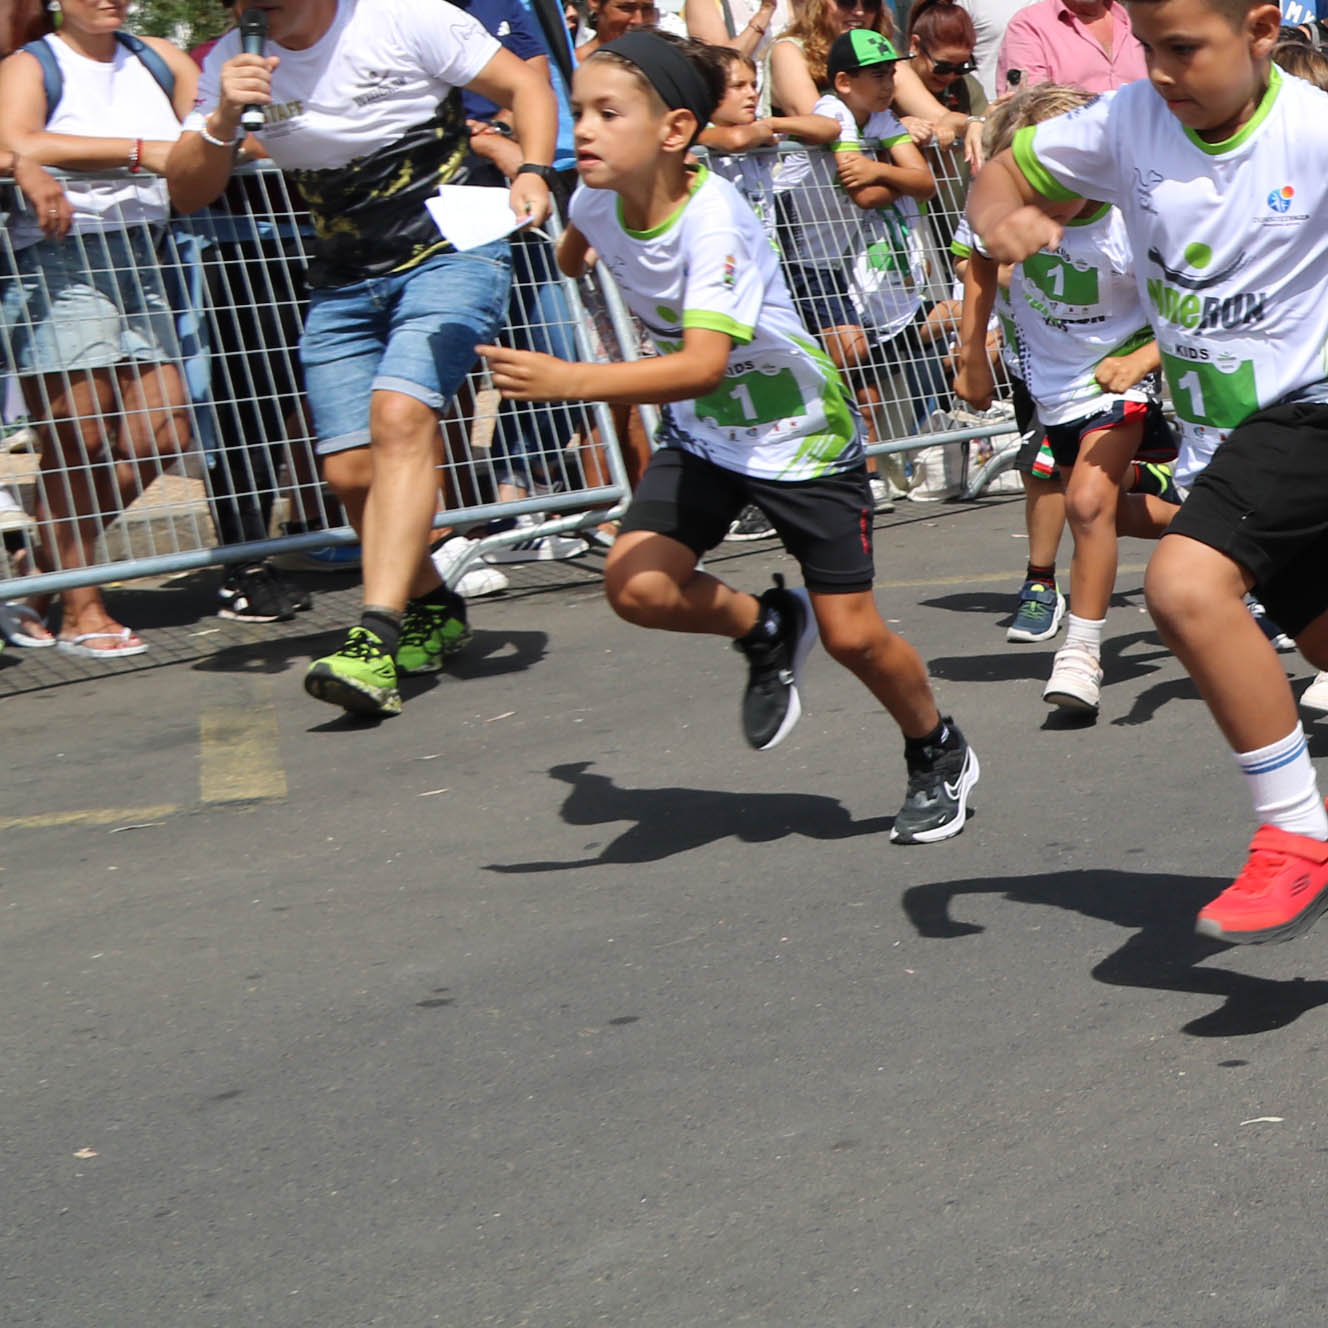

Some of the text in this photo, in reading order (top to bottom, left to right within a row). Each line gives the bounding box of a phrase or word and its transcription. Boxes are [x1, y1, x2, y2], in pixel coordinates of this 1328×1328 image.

[1047, 263, 1065, 297] 1
[1175, 344, 1210, 360] KIDS
[729, 383, 758, 420] 1
[1178, 370, 1207, 417] 1
